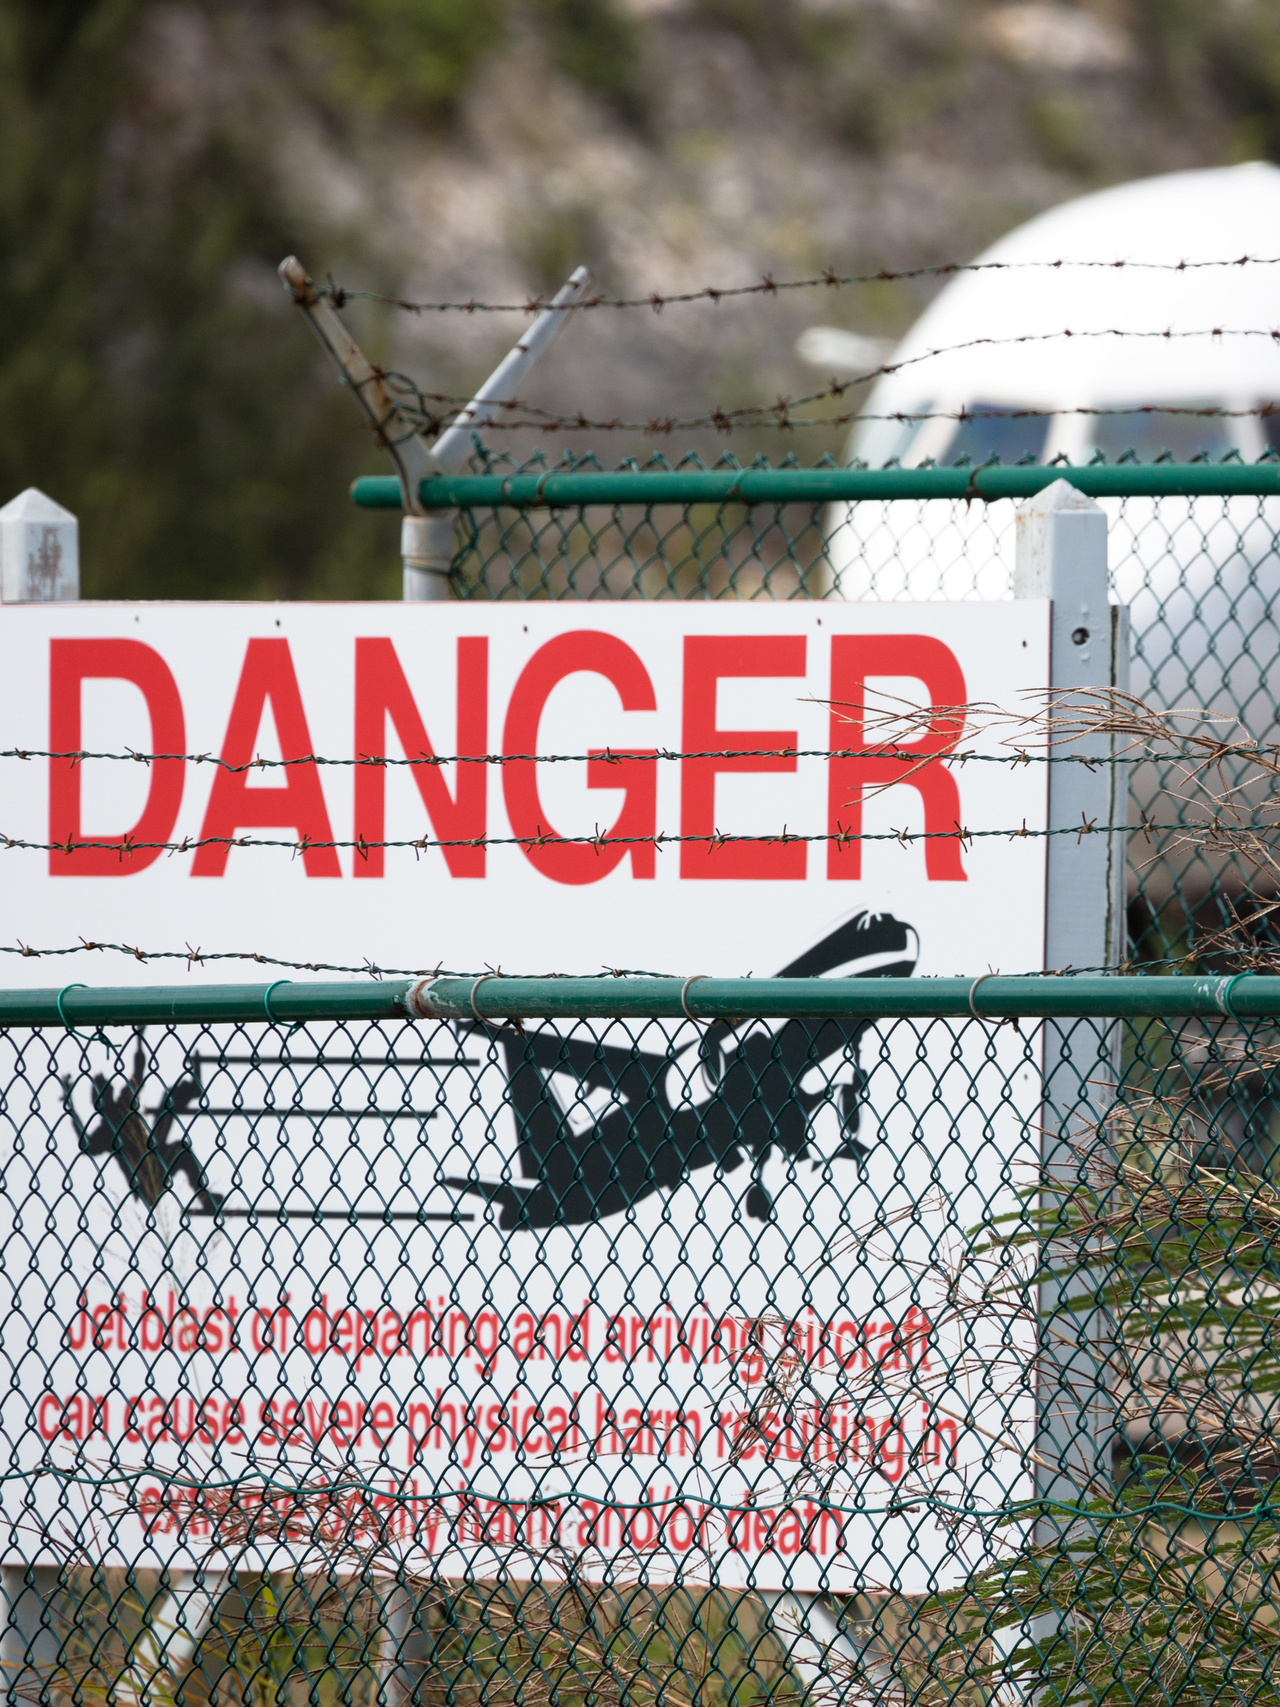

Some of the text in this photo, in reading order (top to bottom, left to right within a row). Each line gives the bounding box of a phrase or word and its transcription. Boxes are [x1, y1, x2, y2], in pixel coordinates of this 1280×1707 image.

[48, 629, 969, 885] DANGER
[67, 1290, 932, 1383] Jet blast of departing and arriving aircraft
[39, 1394, 109, 1442] can
[124, 1395, 246, 1446] cause
[258, 1398, 395, 1449] severe
[407, 1388, 579, 1468] physical
[596, 1394, 701, 1457] harm
[922, 1402, 958, 1466] in
[459, 1481, 562, 1544] harm
[576, 1485, 715, 1552] and/or
[725, 1490, 843, 1556] death
